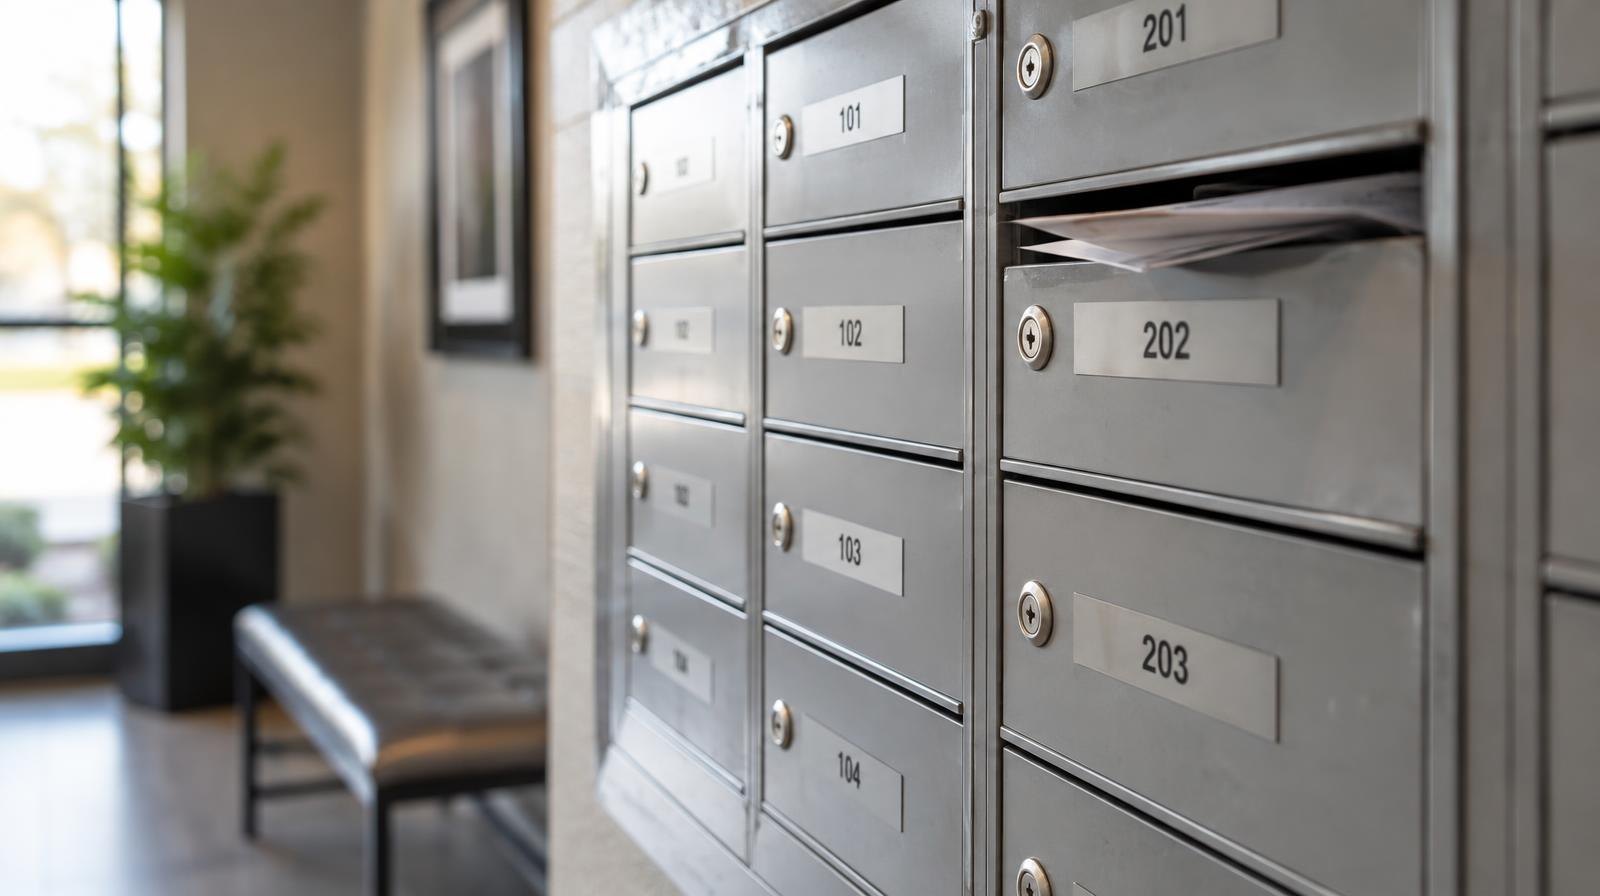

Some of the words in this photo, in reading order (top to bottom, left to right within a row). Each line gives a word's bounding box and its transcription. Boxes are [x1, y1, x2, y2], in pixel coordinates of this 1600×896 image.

[1143, 2, 1187, 52] 201
[839, 103, 862, 133] 101
[839, 319, 863, 347] 102
[1143, 320, 1191, 360] 202
[838, 533, 862, 566] 103
[1142, 634, 1189, 685] 203
[838, 752, 862, 789] 104
